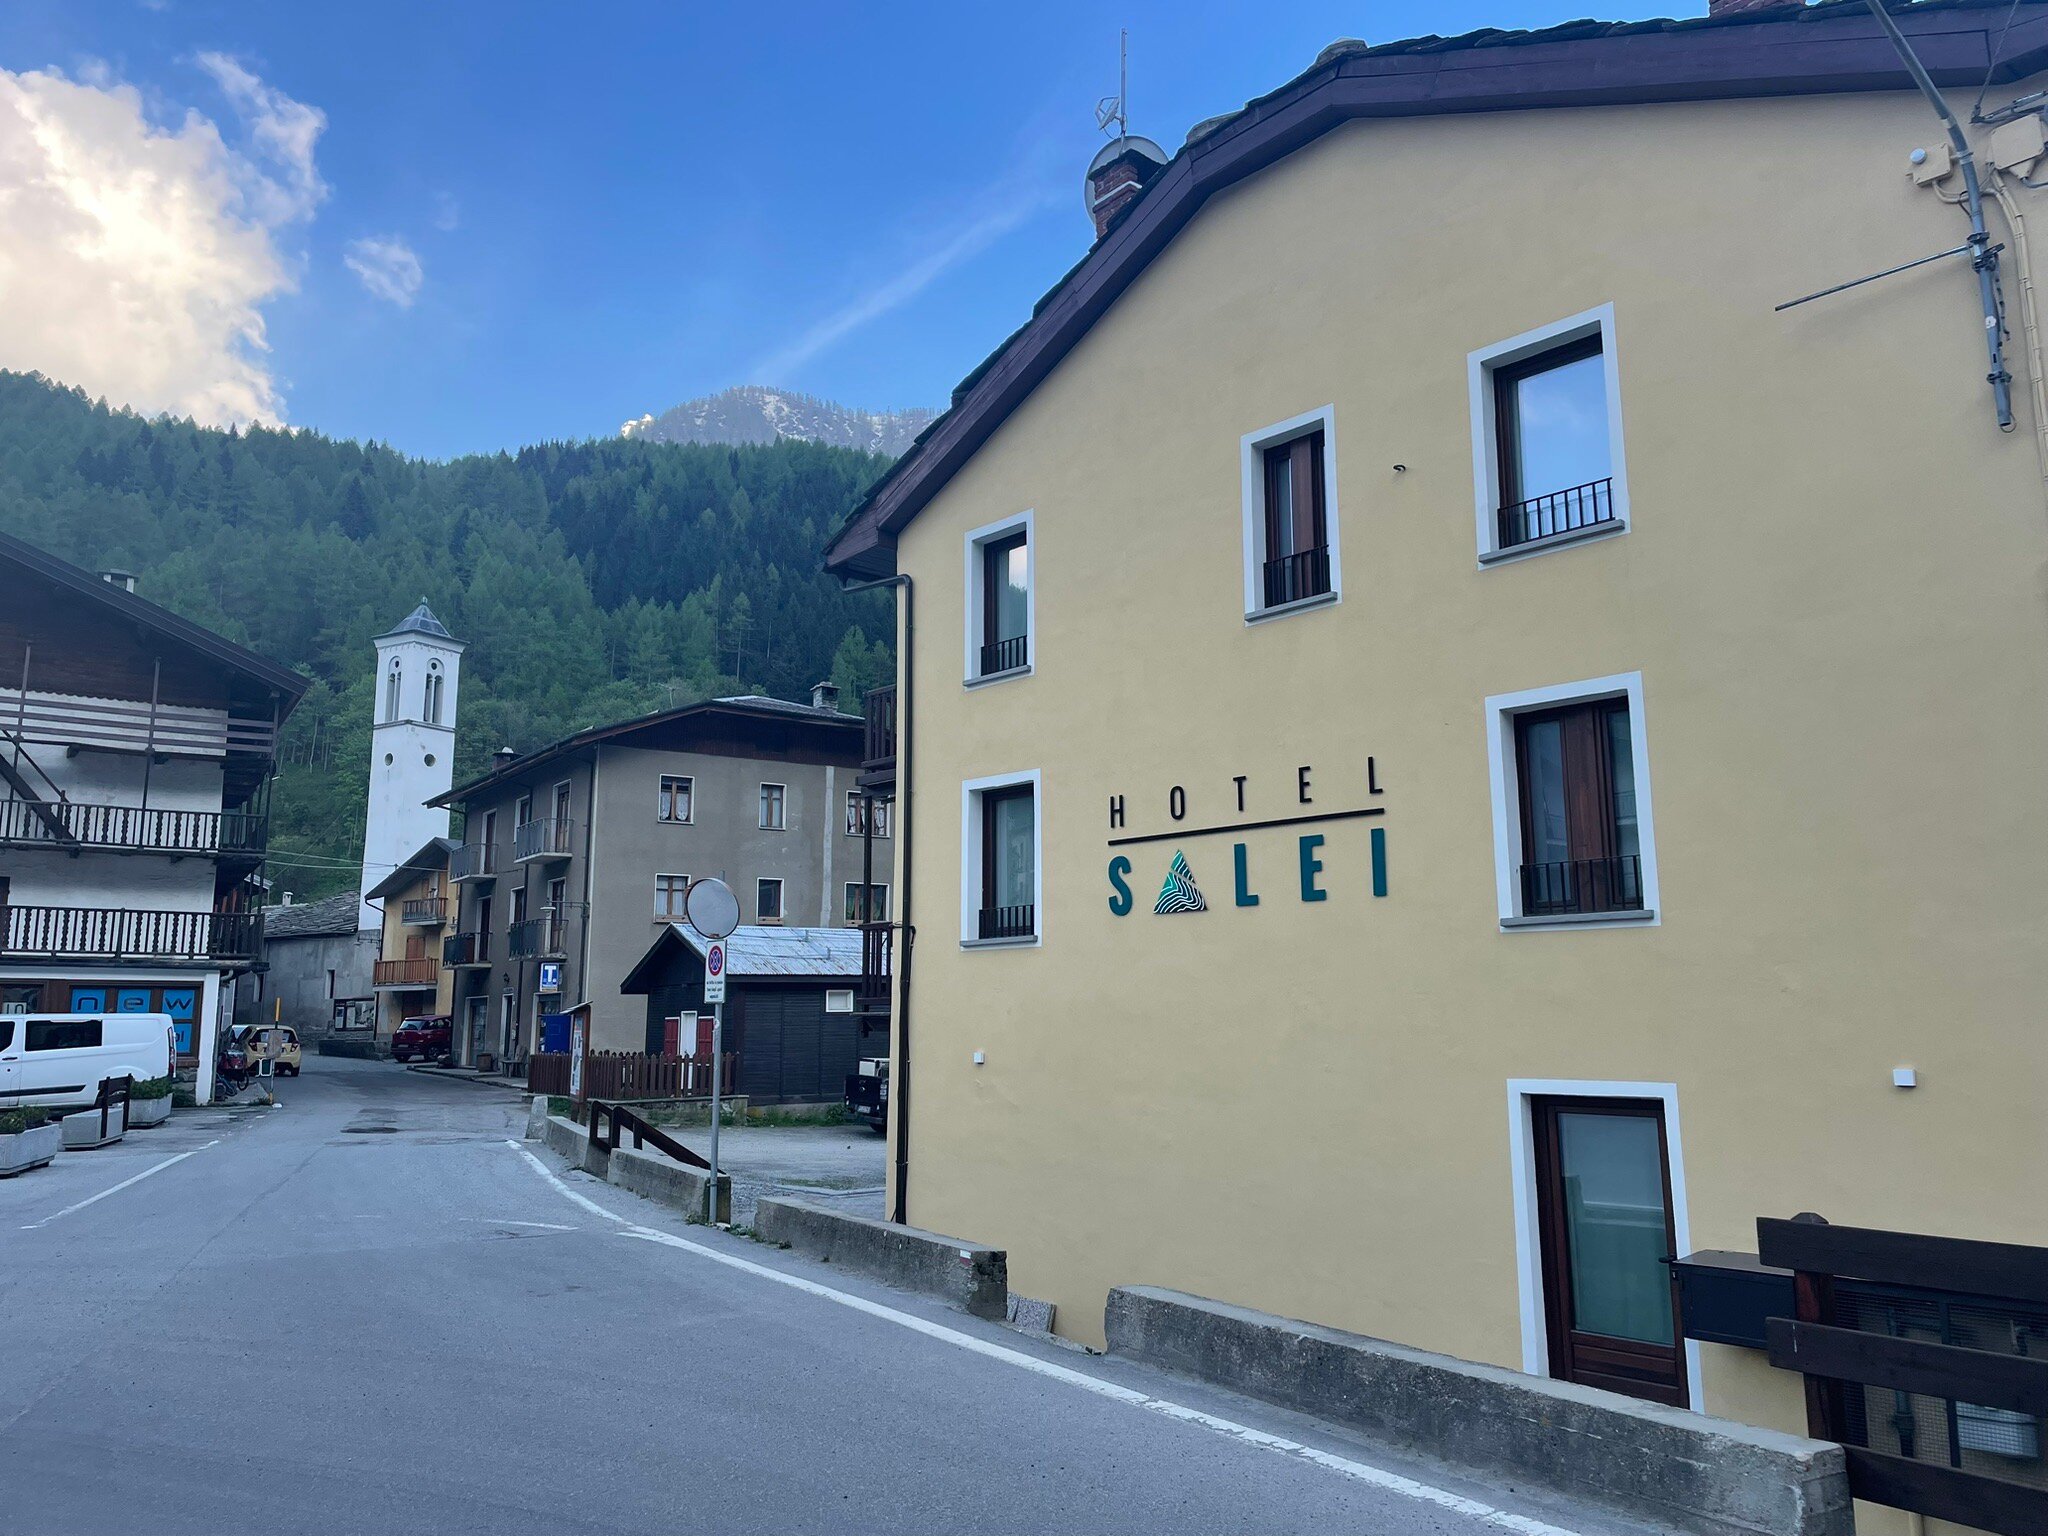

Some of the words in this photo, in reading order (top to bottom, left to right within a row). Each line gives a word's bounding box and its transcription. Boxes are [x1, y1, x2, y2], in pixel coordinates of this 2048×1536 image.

[1109, 756, 1384, 829] HOTEL
[1108, 827, 1388, 917] SALEI
[77, 997, 192, 1011] new
